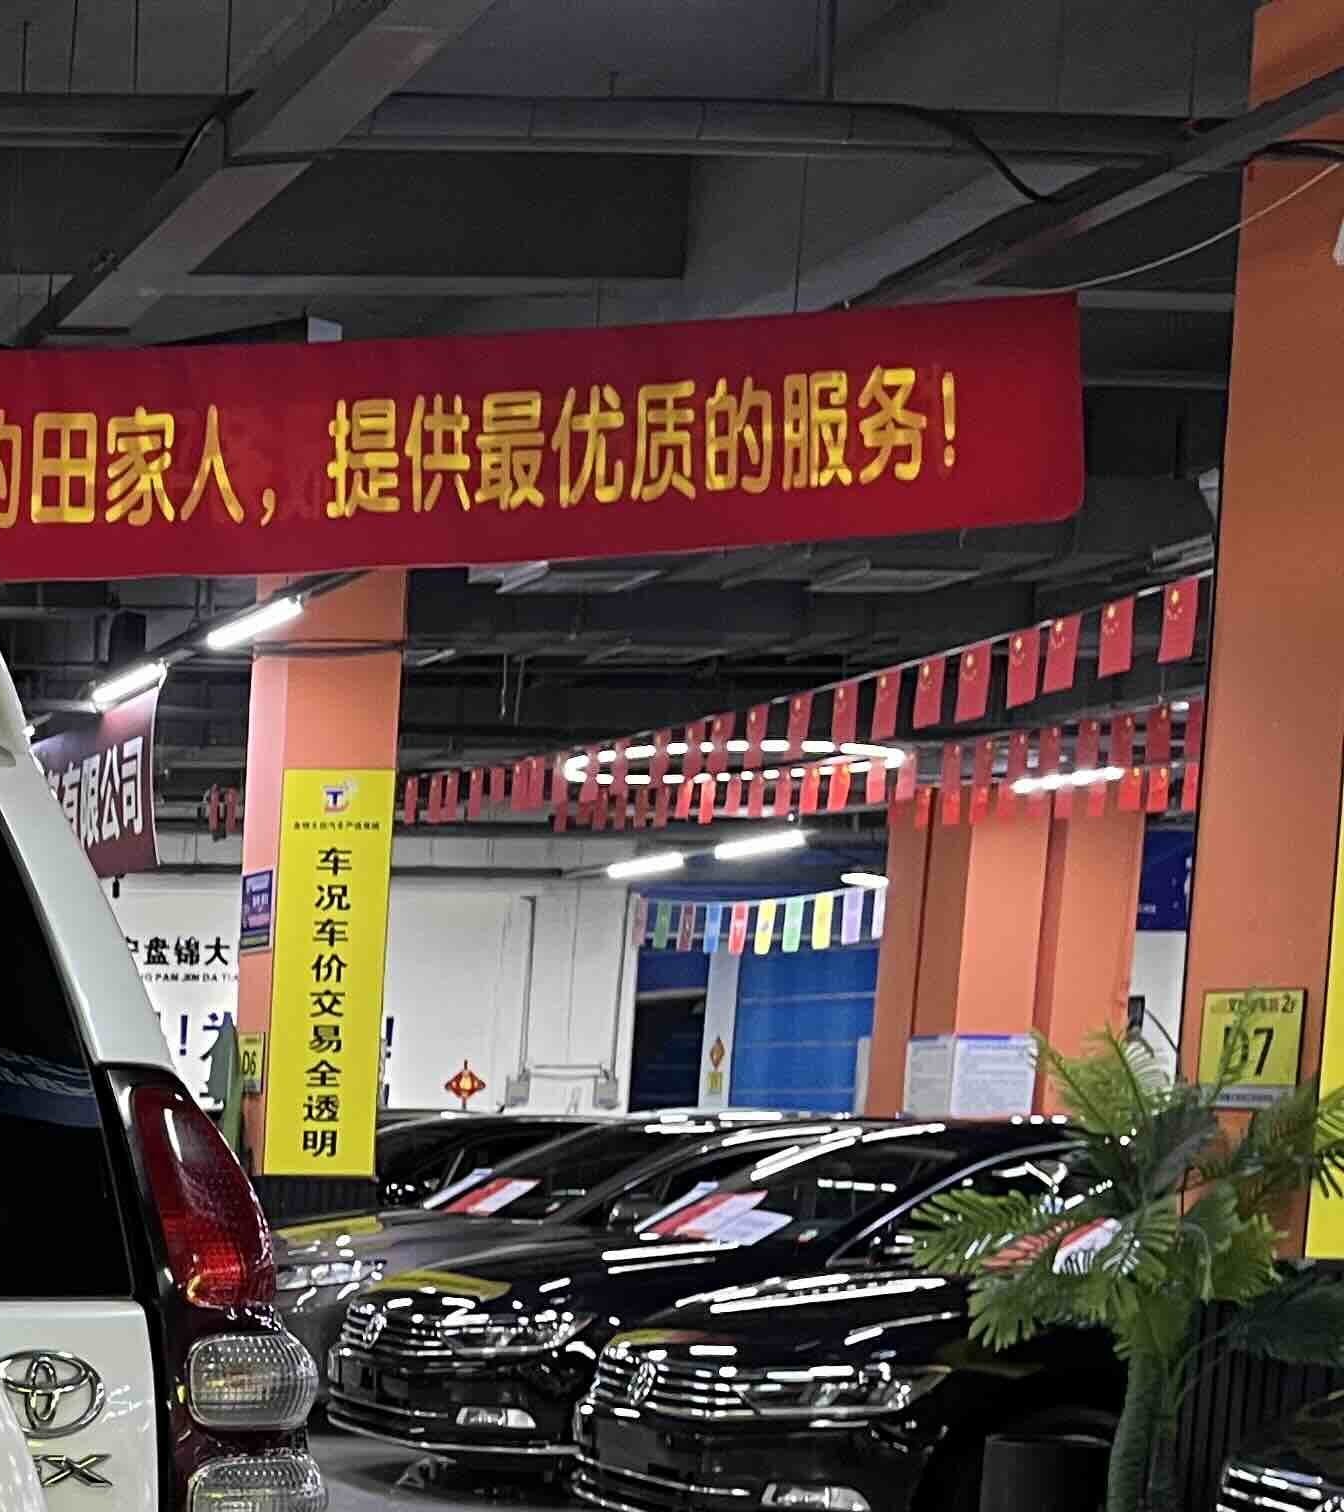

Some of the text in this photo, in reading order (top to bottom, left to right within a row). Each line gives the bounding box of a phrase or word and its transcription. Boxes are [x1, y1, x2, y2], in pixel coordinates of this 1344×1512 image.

[47, 736, 143, 848] 有限公司
[302, 847, 352, 1157] 车况车价交易全透明
[31, 1453, 113, 1489] X
